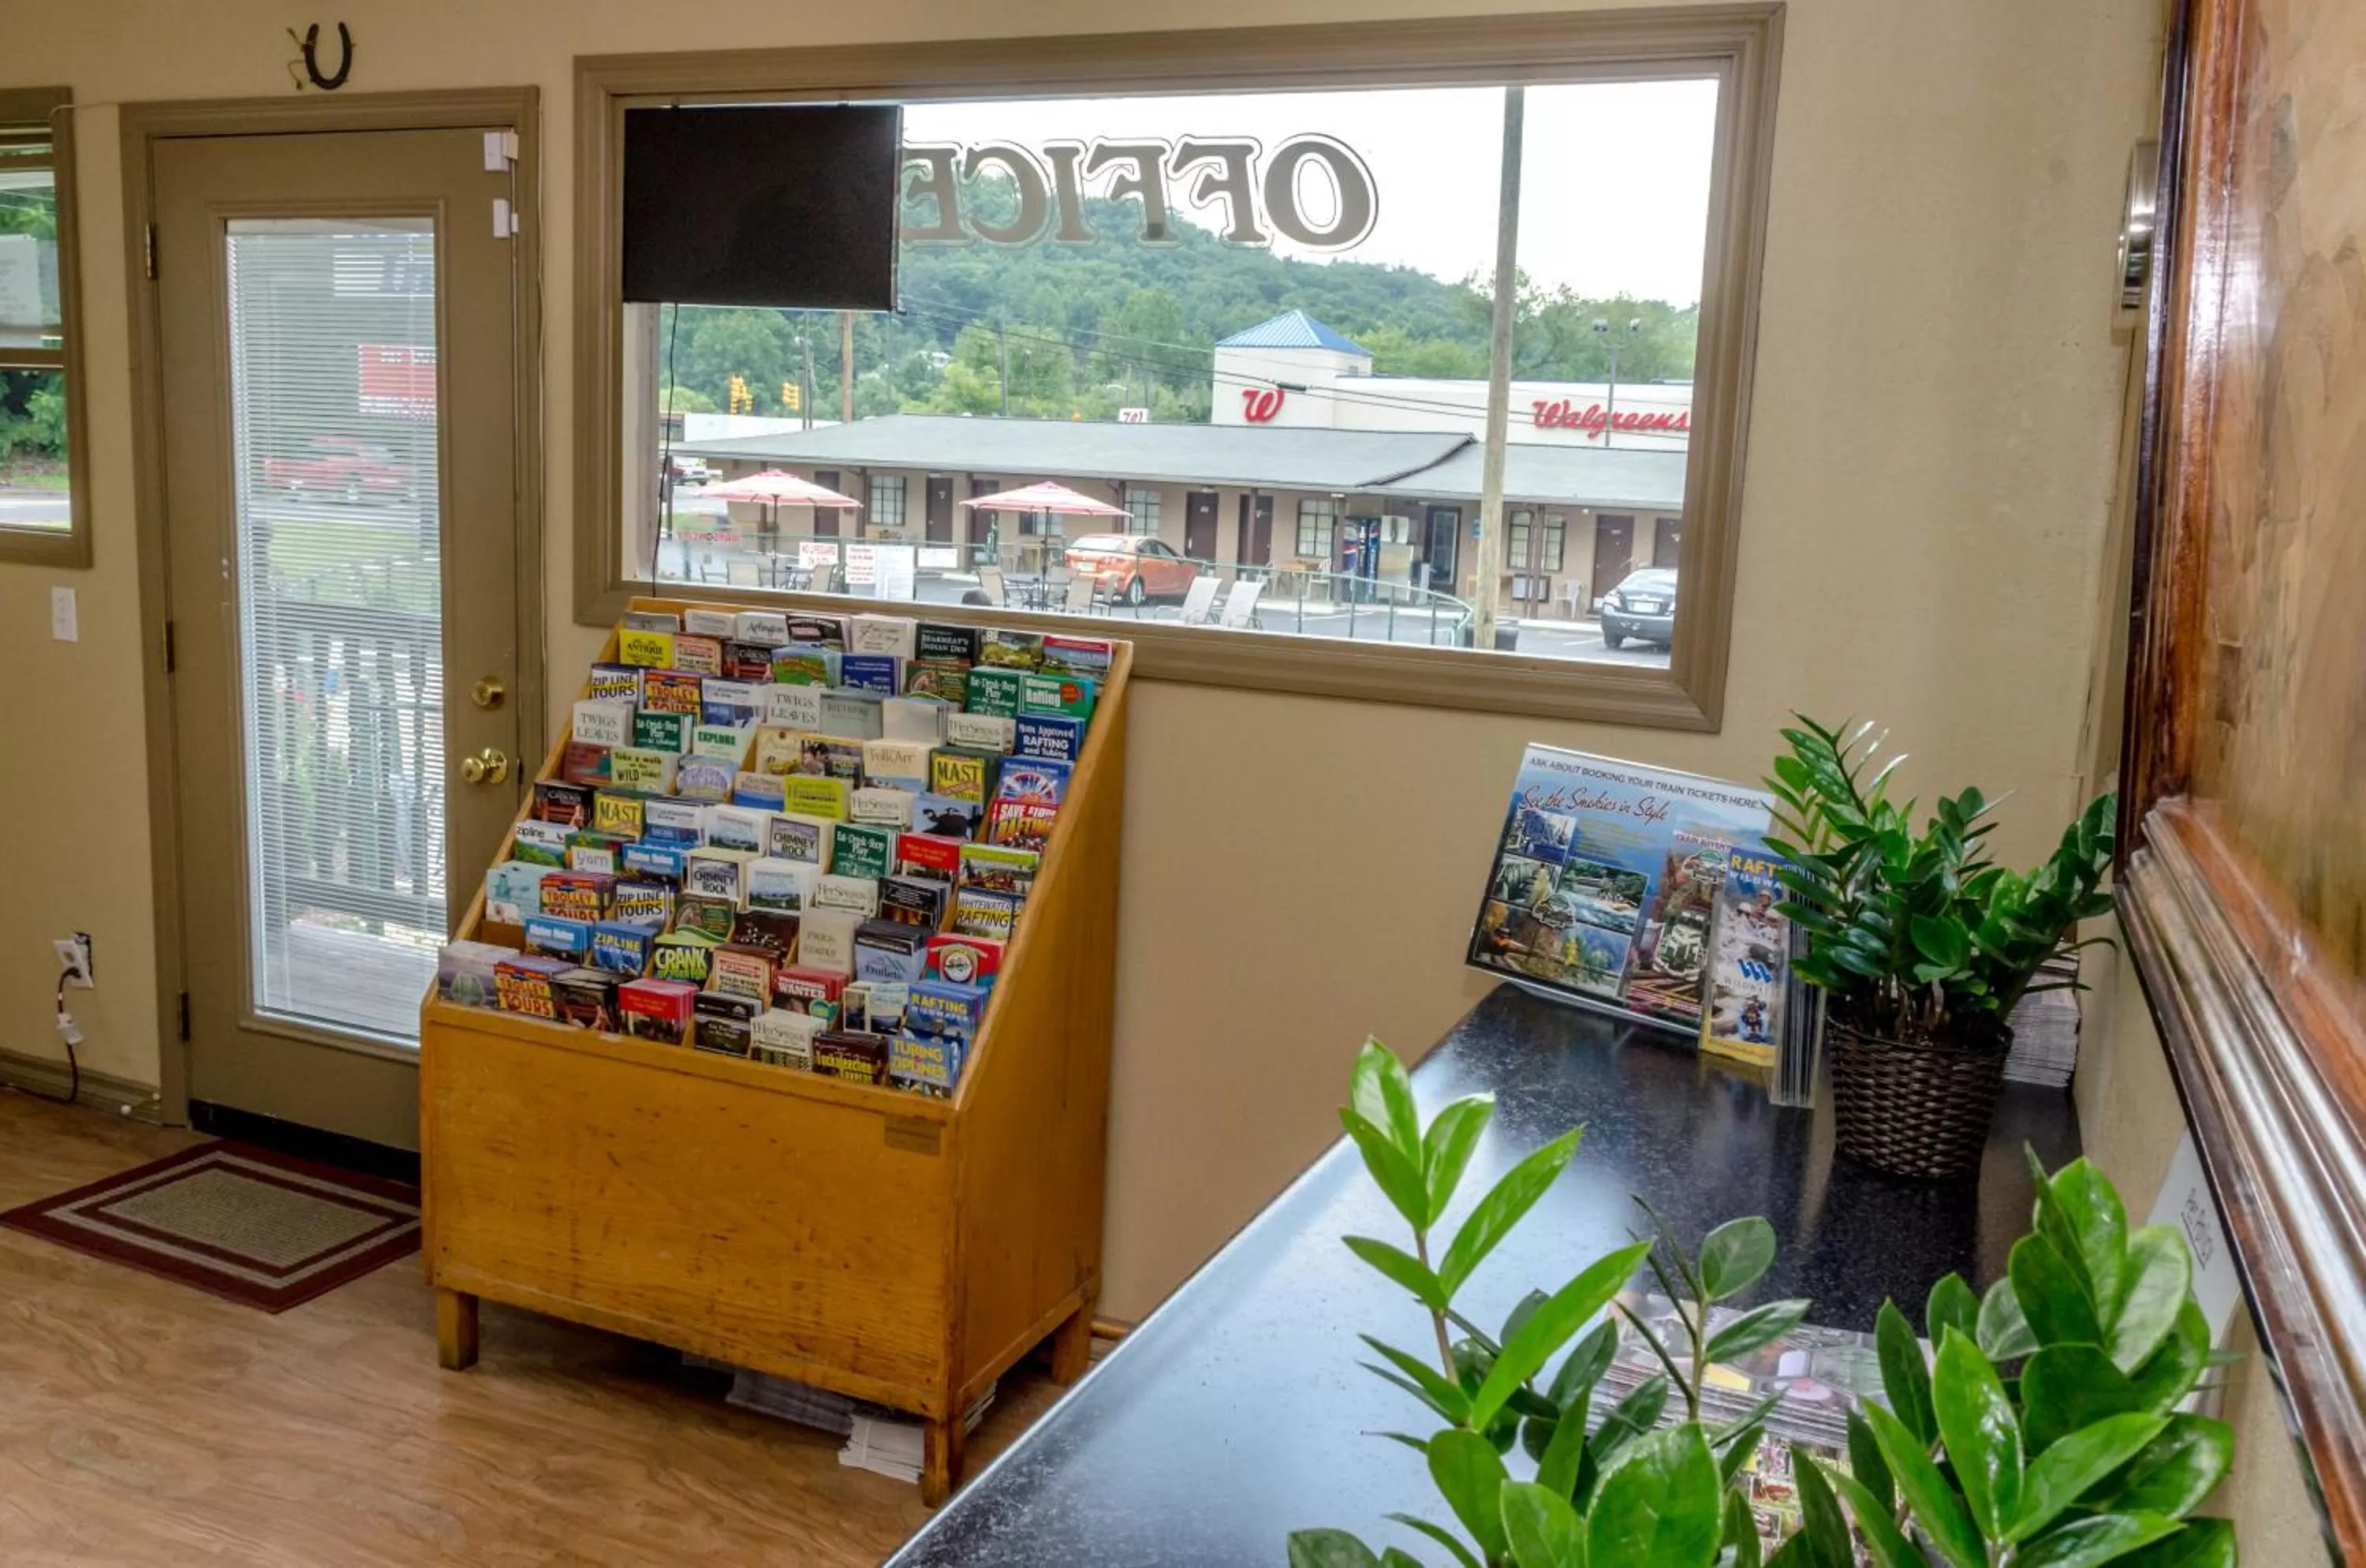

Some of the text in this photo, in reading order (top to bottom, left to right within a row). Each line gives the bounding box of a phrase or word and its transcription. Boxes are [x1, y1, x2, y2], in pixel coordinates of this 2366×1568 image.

[1532, 398, 1691, 440] Walgreens
[592, 685, 636, 700] TOURS
[1022, 734, 1069, 750] RAFTING
[936, 760, 980, 782] MAST
[1548, 760, 1581, 775] ABOUT
[1581, 767, 1625, 785] BOOKING
[1627, 775, 1654, 790] YOUR
[1655, 781, 1685, 797] TRAIN
[1686, 786, 1728, 803] TICKETS
[598, 801, 640, 823] MAST
[999, 804, 1027, 820] SAVE
[1566, 786, 1616, 812] Smokies
[1633, 796, 1670, 827] Style
[773, 831, 815, 849] CHIMNEY
[694, 870, 734, 887] CHIMNEY
[617, 892, 636, 904] ZIP
[703, 882, 727, 896] ROCK
[617, 902, 663, 918] TOURS
[959, 909, 1013, 929] RAFTING
[655, 946, 707, 970] CRANK
[505, 992, 552, 1017] TOURS
[911, 991, 968, 1015] RAFTING
